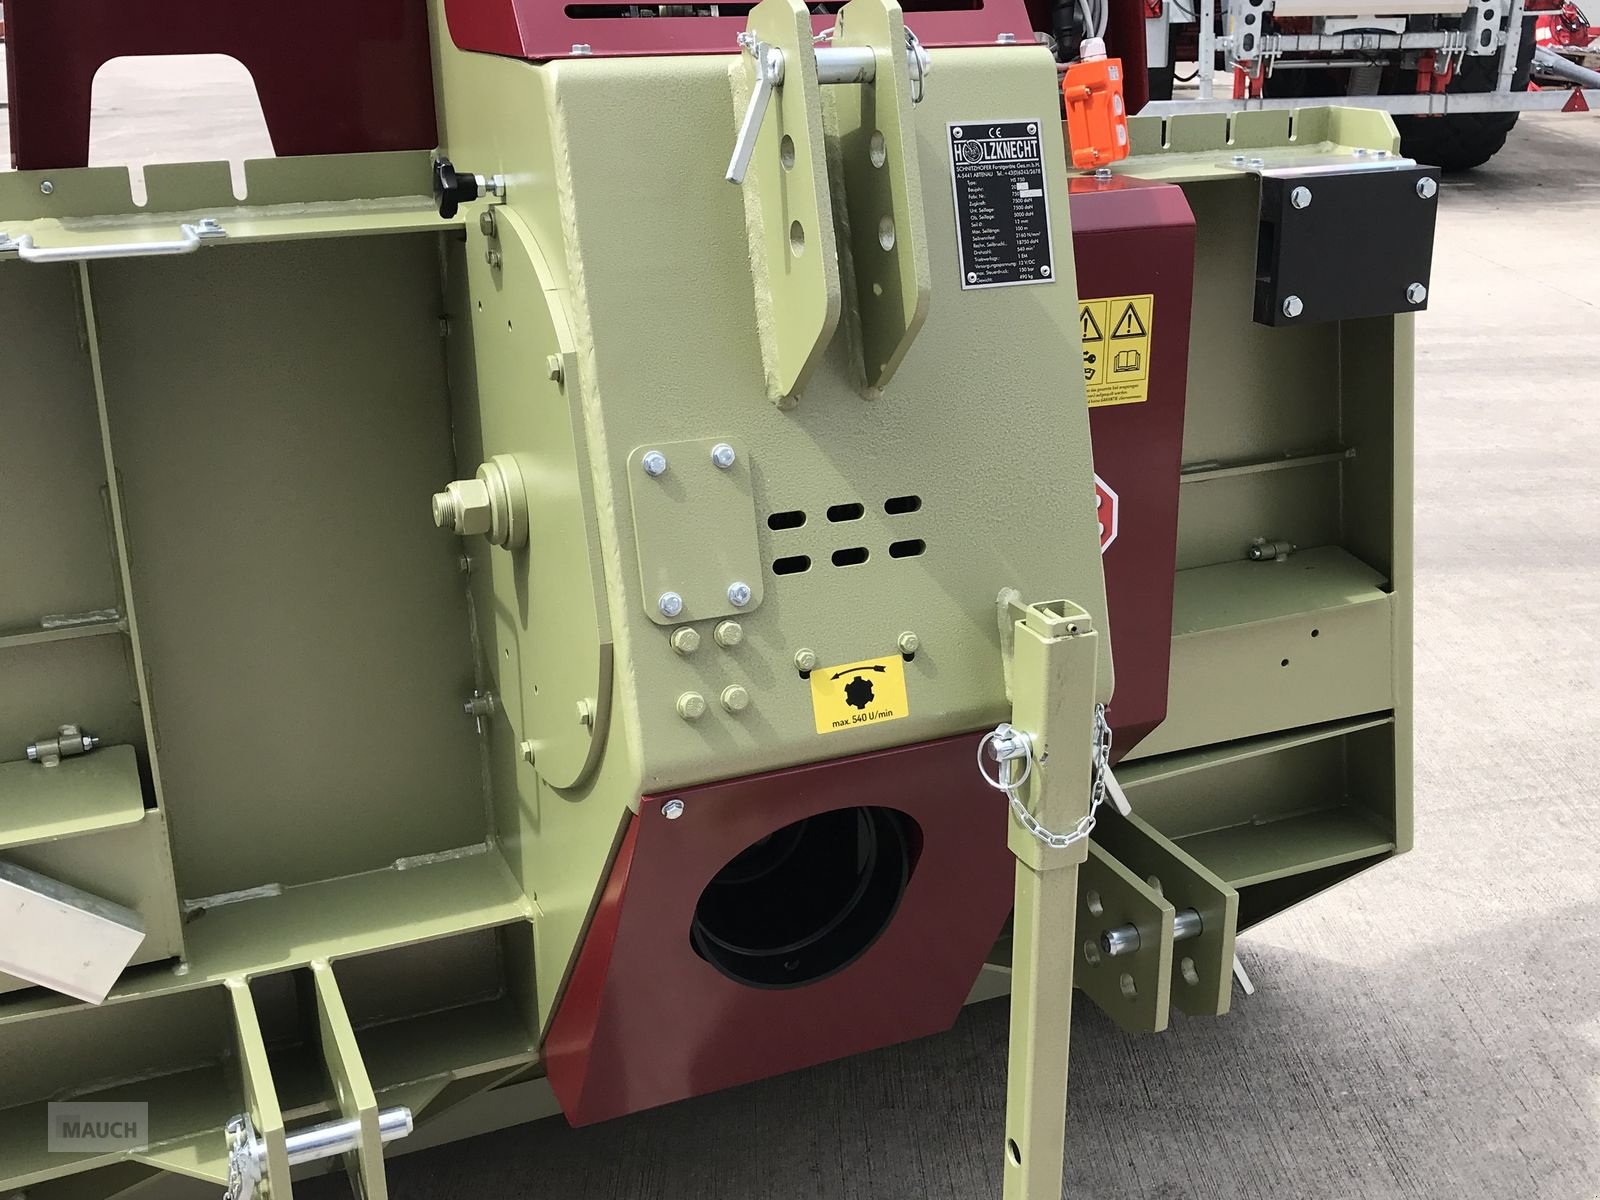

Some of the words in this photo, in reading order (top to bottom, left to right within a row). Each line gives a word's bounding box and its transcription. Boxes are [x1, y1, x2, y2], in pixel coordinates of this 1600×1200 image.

[832, 719, 851, 728] max.
[852, 713, 868, 724] 540
[869, 709, 893, 721] U/min
